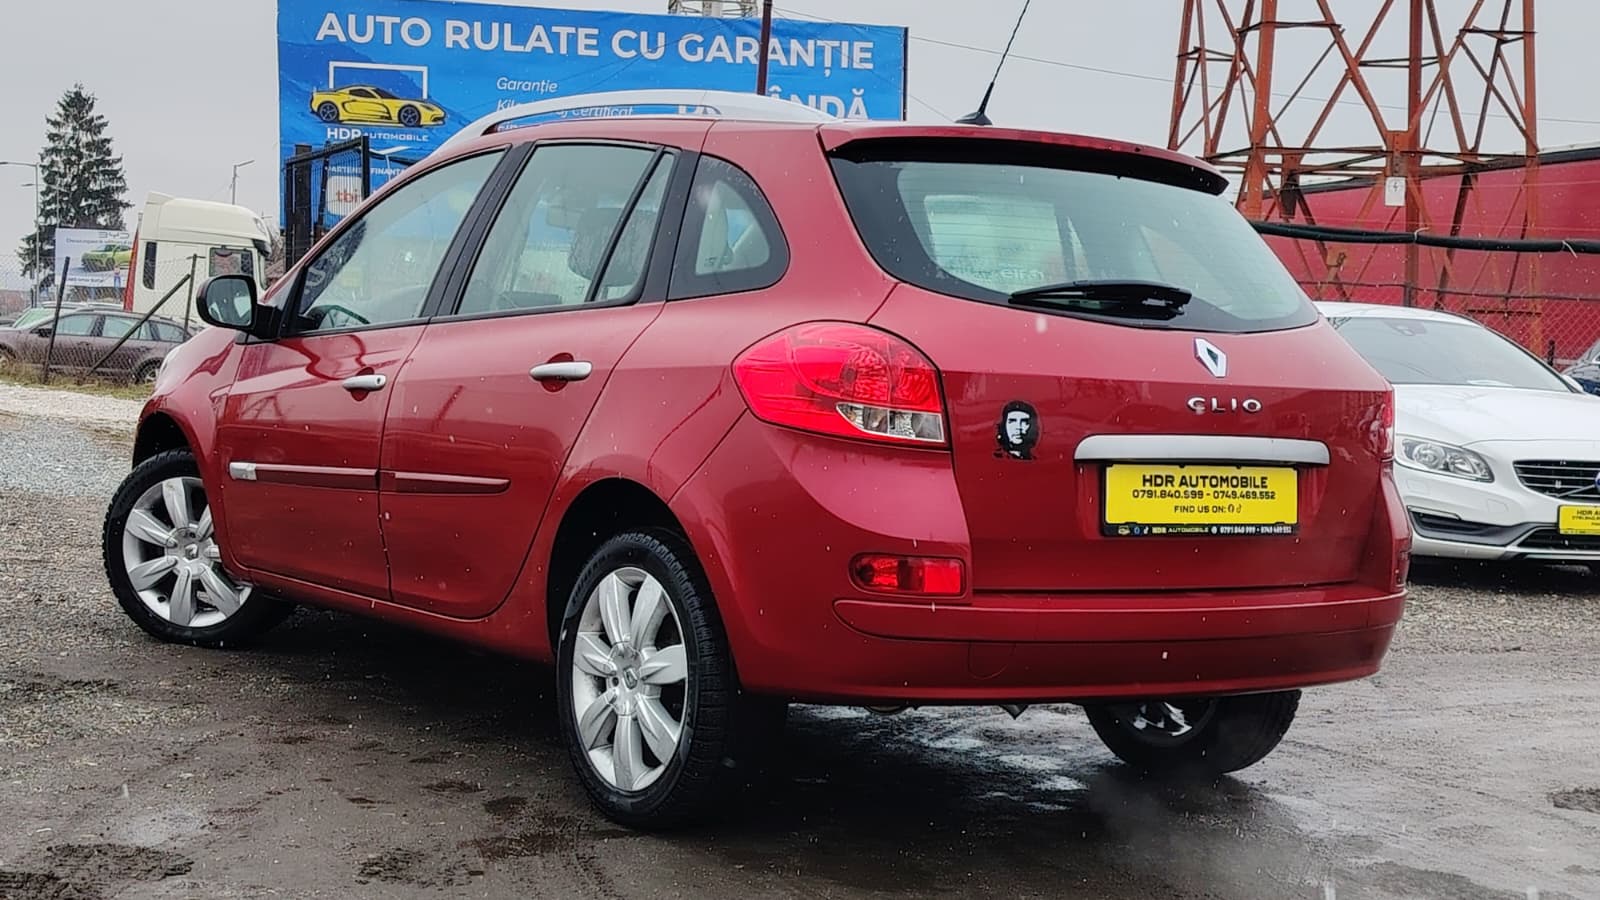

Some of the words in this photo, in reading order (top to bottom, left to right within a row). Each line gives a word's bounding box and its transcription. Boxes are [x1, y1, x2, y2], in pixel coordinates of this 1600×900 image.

[316, 13, 431, 47] AUTO
[446, 20, 599, 56] RULATE
[611, 29, 665, 60] CU
[678, 34, 874, 78] GARANȚIE
[496, 77, 558, 93] Garanție
[1187, 397, 1262, 412] CLIO
[1142, 474, 1175, 488] HDR
[1178, 475, 1268, 489] AUTOMOBILE
[1173, 505, 1195, 514] FIND
[1197, 505, 1210, 514] US
[1211, 505, 1227, 514] ON:
